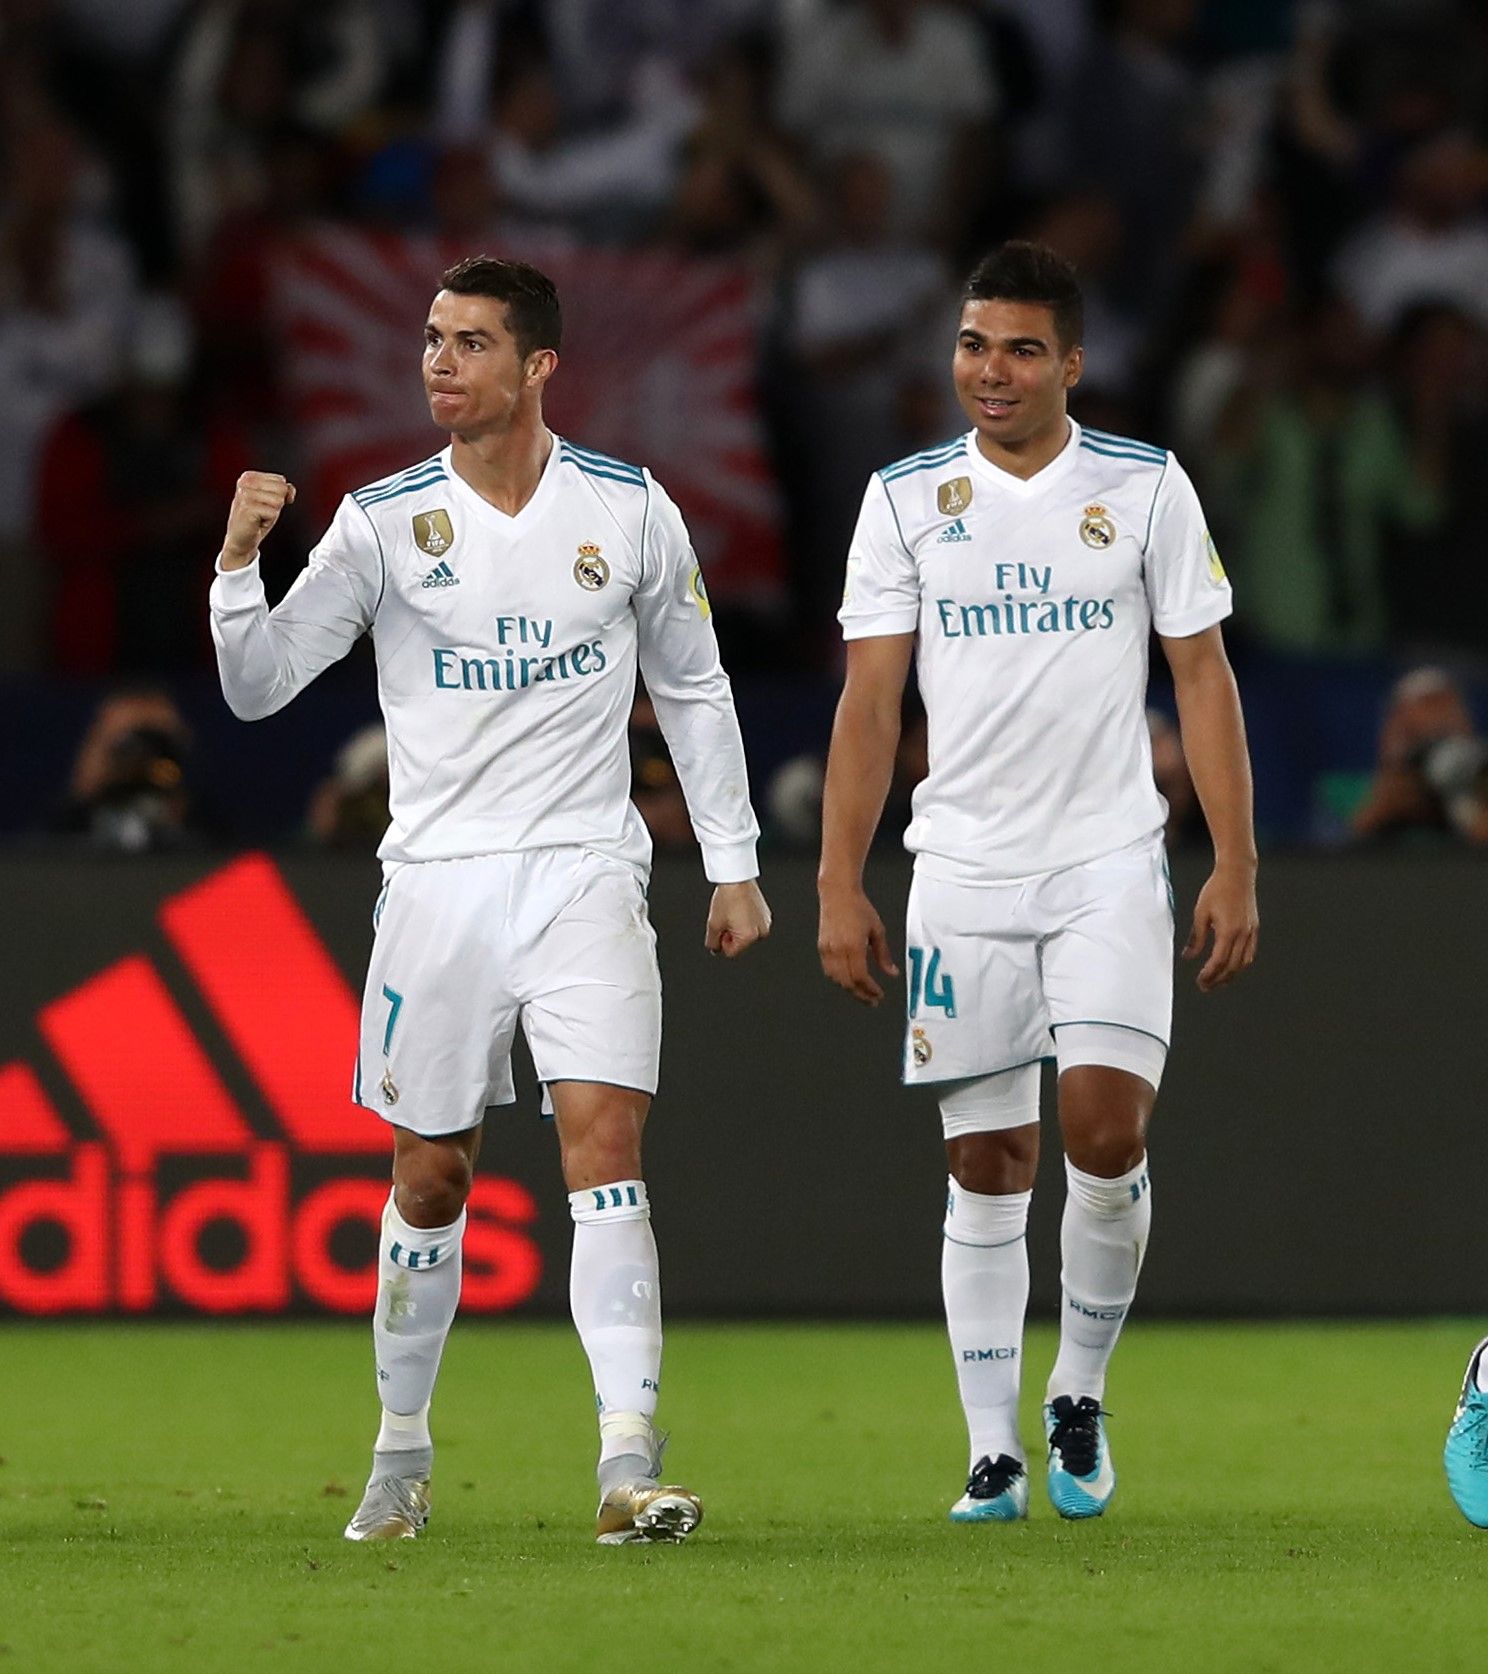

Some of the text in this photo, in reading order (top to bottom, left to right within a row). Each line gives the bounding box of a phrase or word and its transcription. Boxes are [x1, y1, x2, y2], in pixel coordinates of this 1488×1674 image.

[422, 577, 460, 589] adidas
[995, 562, 1052, 594] Fly
[496, 616, 552, 648] Fly
[936, 595, 1115, 638] Emirates
[432, 640, 606, 690] Emirates
[908, 946, 957, 1019] 14
[382, 983, 403, 1057] 7
[0, 1141, 542, 1315] didas
[963, 1347, 1018, 1362] RMCF
